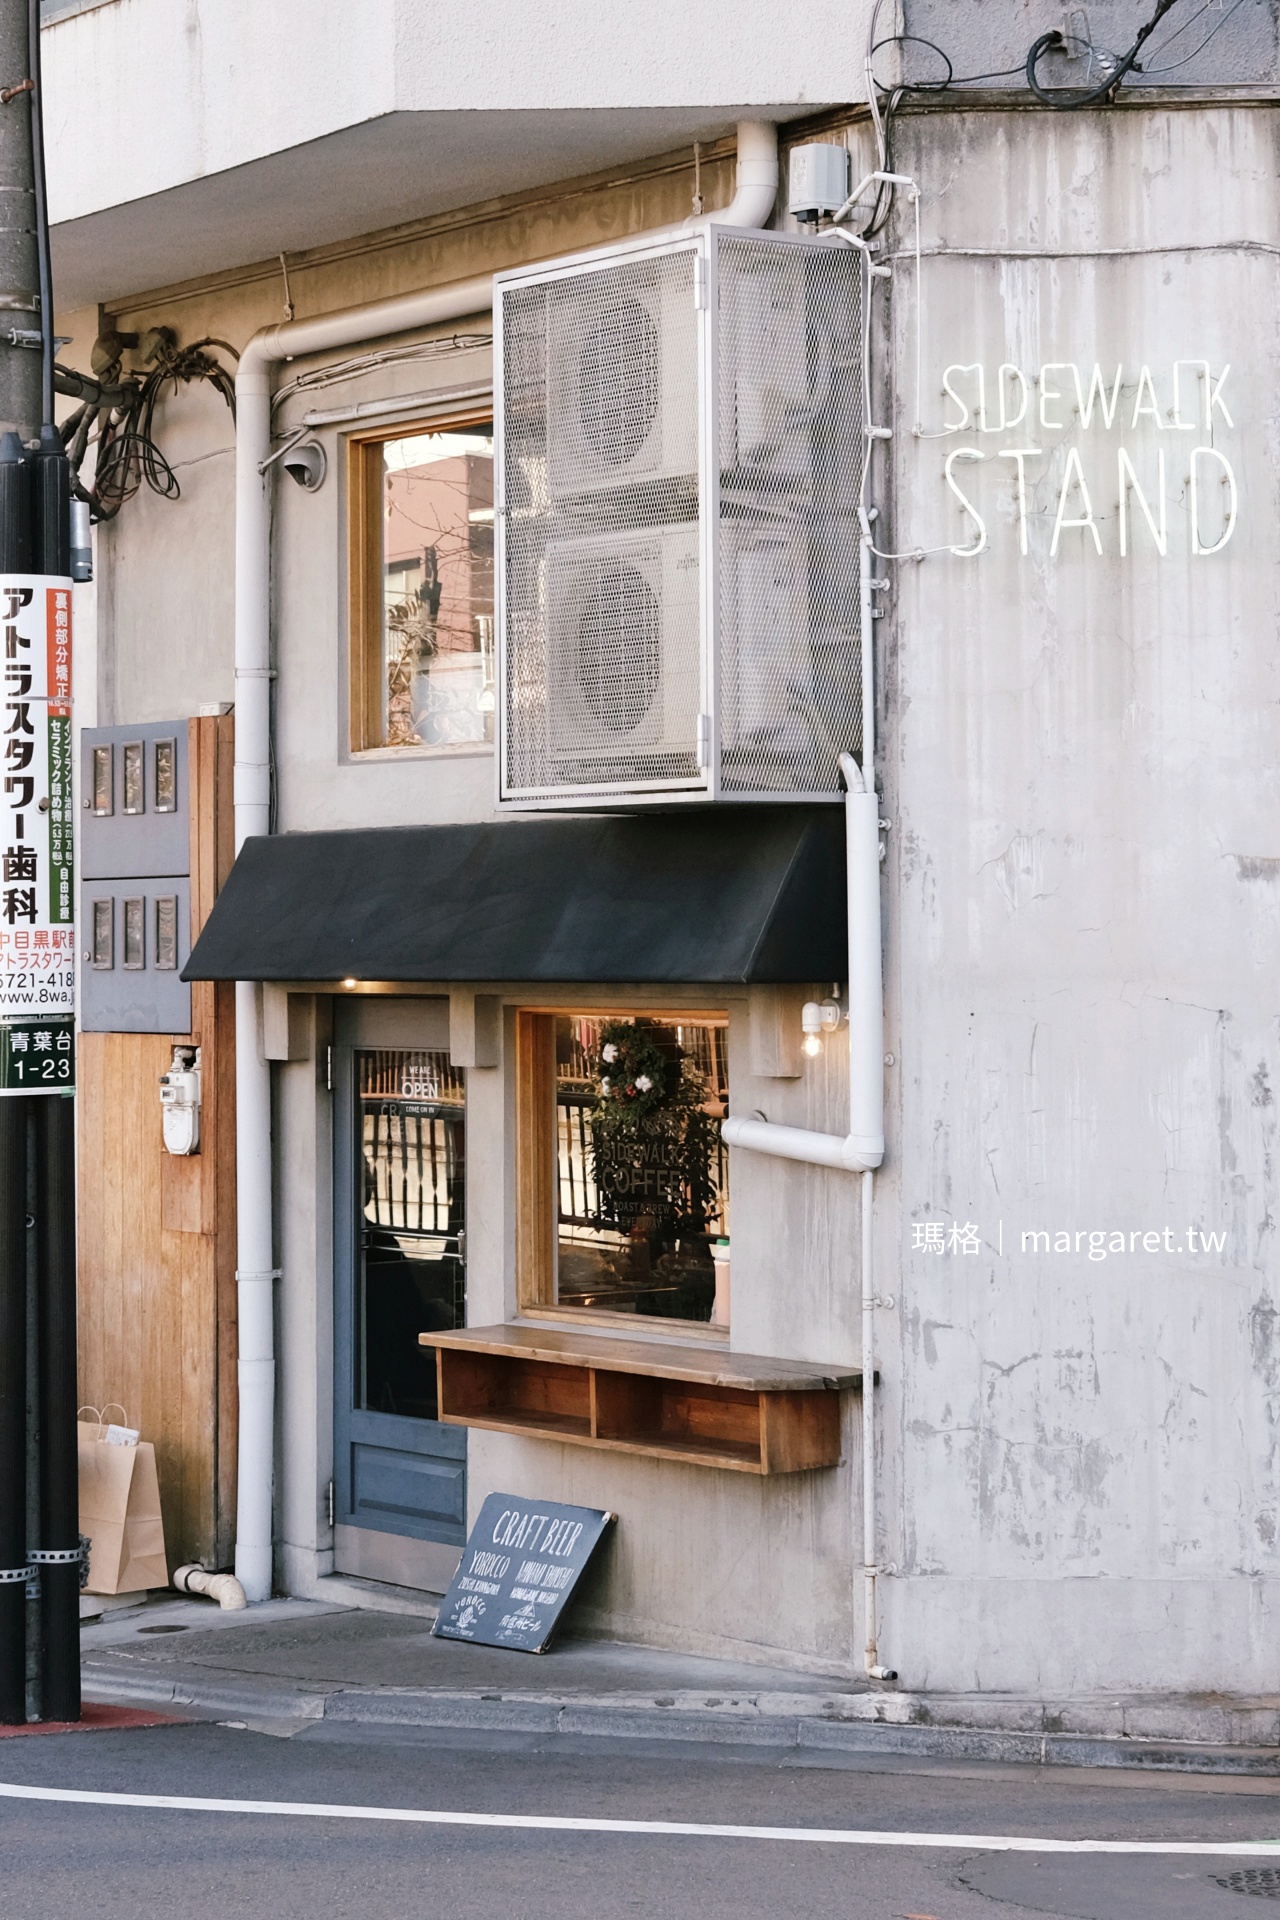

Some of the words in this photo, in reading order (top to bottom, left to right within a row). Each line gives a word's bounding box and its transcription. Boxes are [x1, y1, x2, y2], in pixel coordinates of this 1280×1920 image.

[942, 360, 1234, 432] SIDEWALK
[944, 447, 1237, 557] STAND
[55, 592, 68, 699] 裏側部分矯正
[2, 588, 38, 924] アトラスタワー歯科
[10, 1030, 71, 1053] 青葉台
[14, 1059, 70, 1080] 1-23
[409, 1066, 419, 1074] WE
[402, 1082, 438, 1100] OPEN
[602, 1142, 680, 1163] SIDEWALK
[602, 1166, 682, 1197] COFFEE
[613, 1200, 638, 1212] ROAST
[493, 1510, 549, 1550] CRAFT
[540, 1518, 583, 1557] BEER
[468, 1550, 511, 1578] YOROCCO
[455, 1594, 487, 1615] YOROCCO
